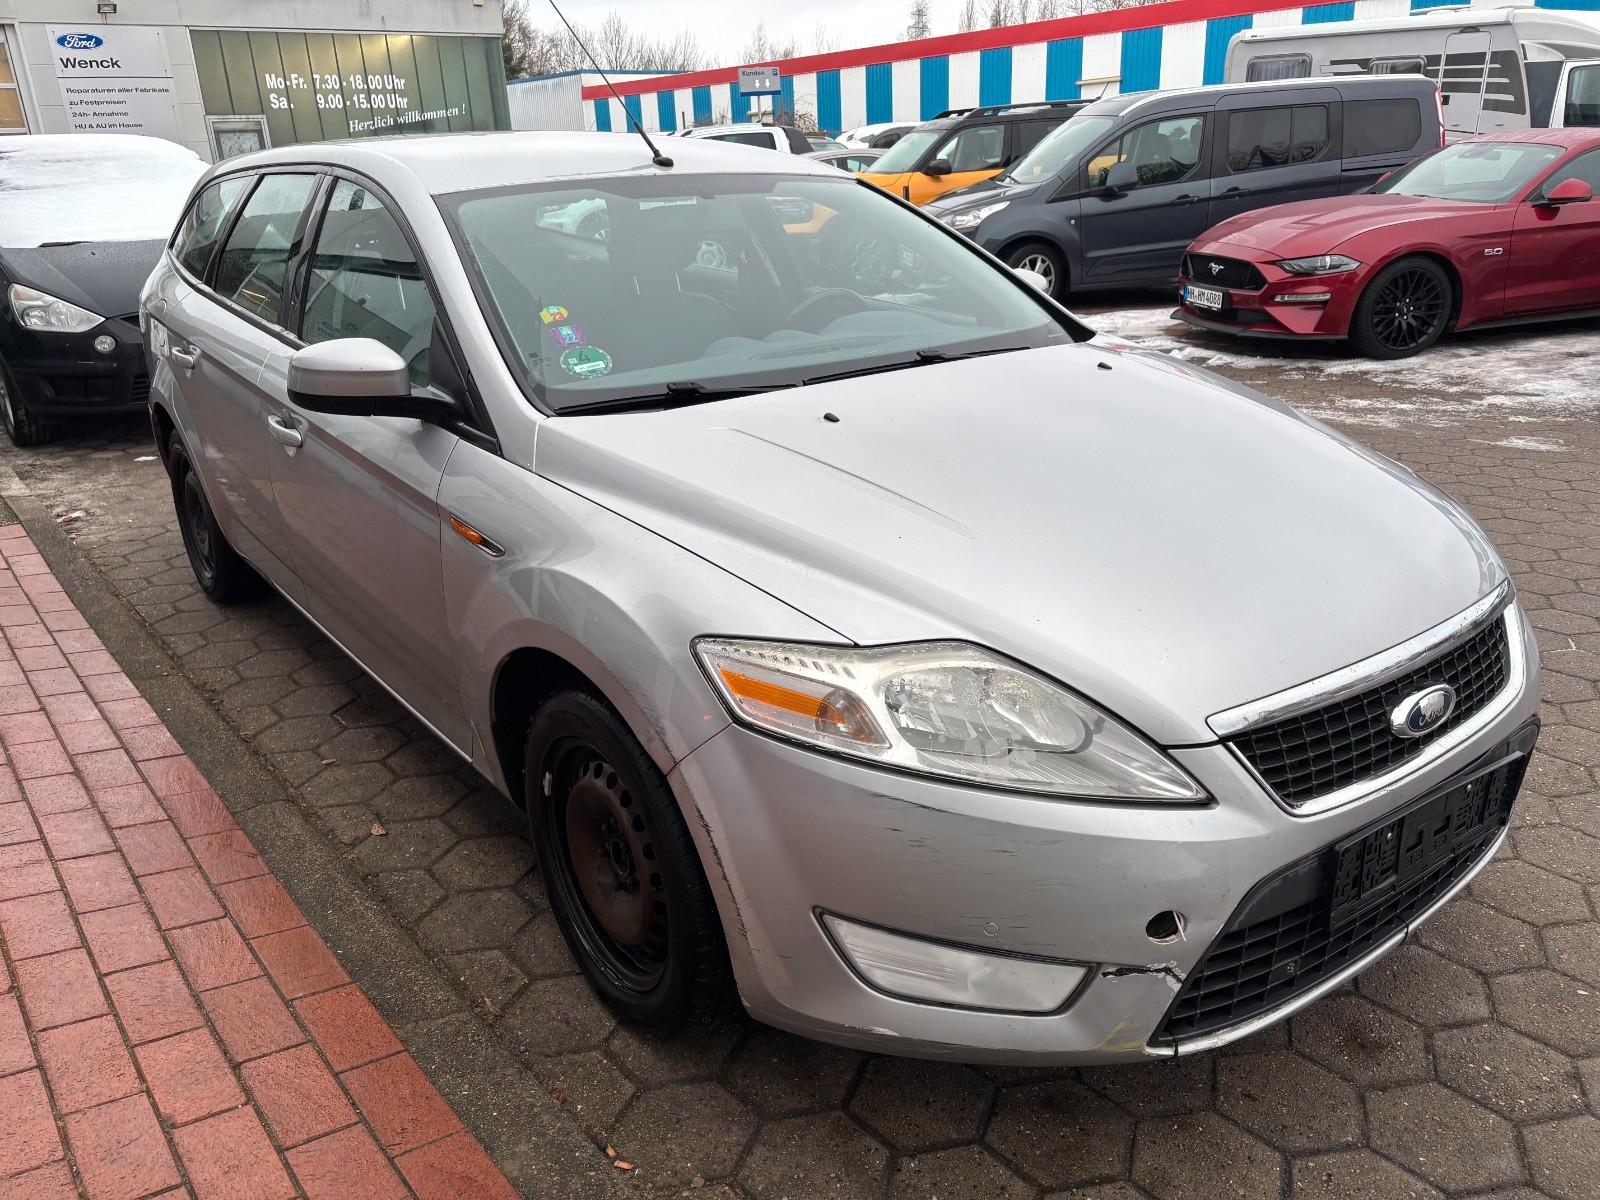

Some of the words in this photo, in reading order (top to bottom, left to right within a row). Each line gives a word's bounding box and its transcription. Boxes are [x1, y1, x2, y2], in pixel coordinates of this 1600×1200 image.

[59, 57, 122, 69] Wenck
[313, 73, 340, 90] 7.30
[350, 74, 382, 90] 18.00
[384, 73, 406, 90] Uhr
[66, 87, 117, 95] Reparaturen
[80, 99, 127, 107] Festpreisen
[317, 93, 343, 109] 9.00
[353, 93, 386, 109] 15.00
[387, 93, 408, 109] Uhr
[349, 115, 394, 132] Herzlich
[396, 106, 459, 125] willkommen
